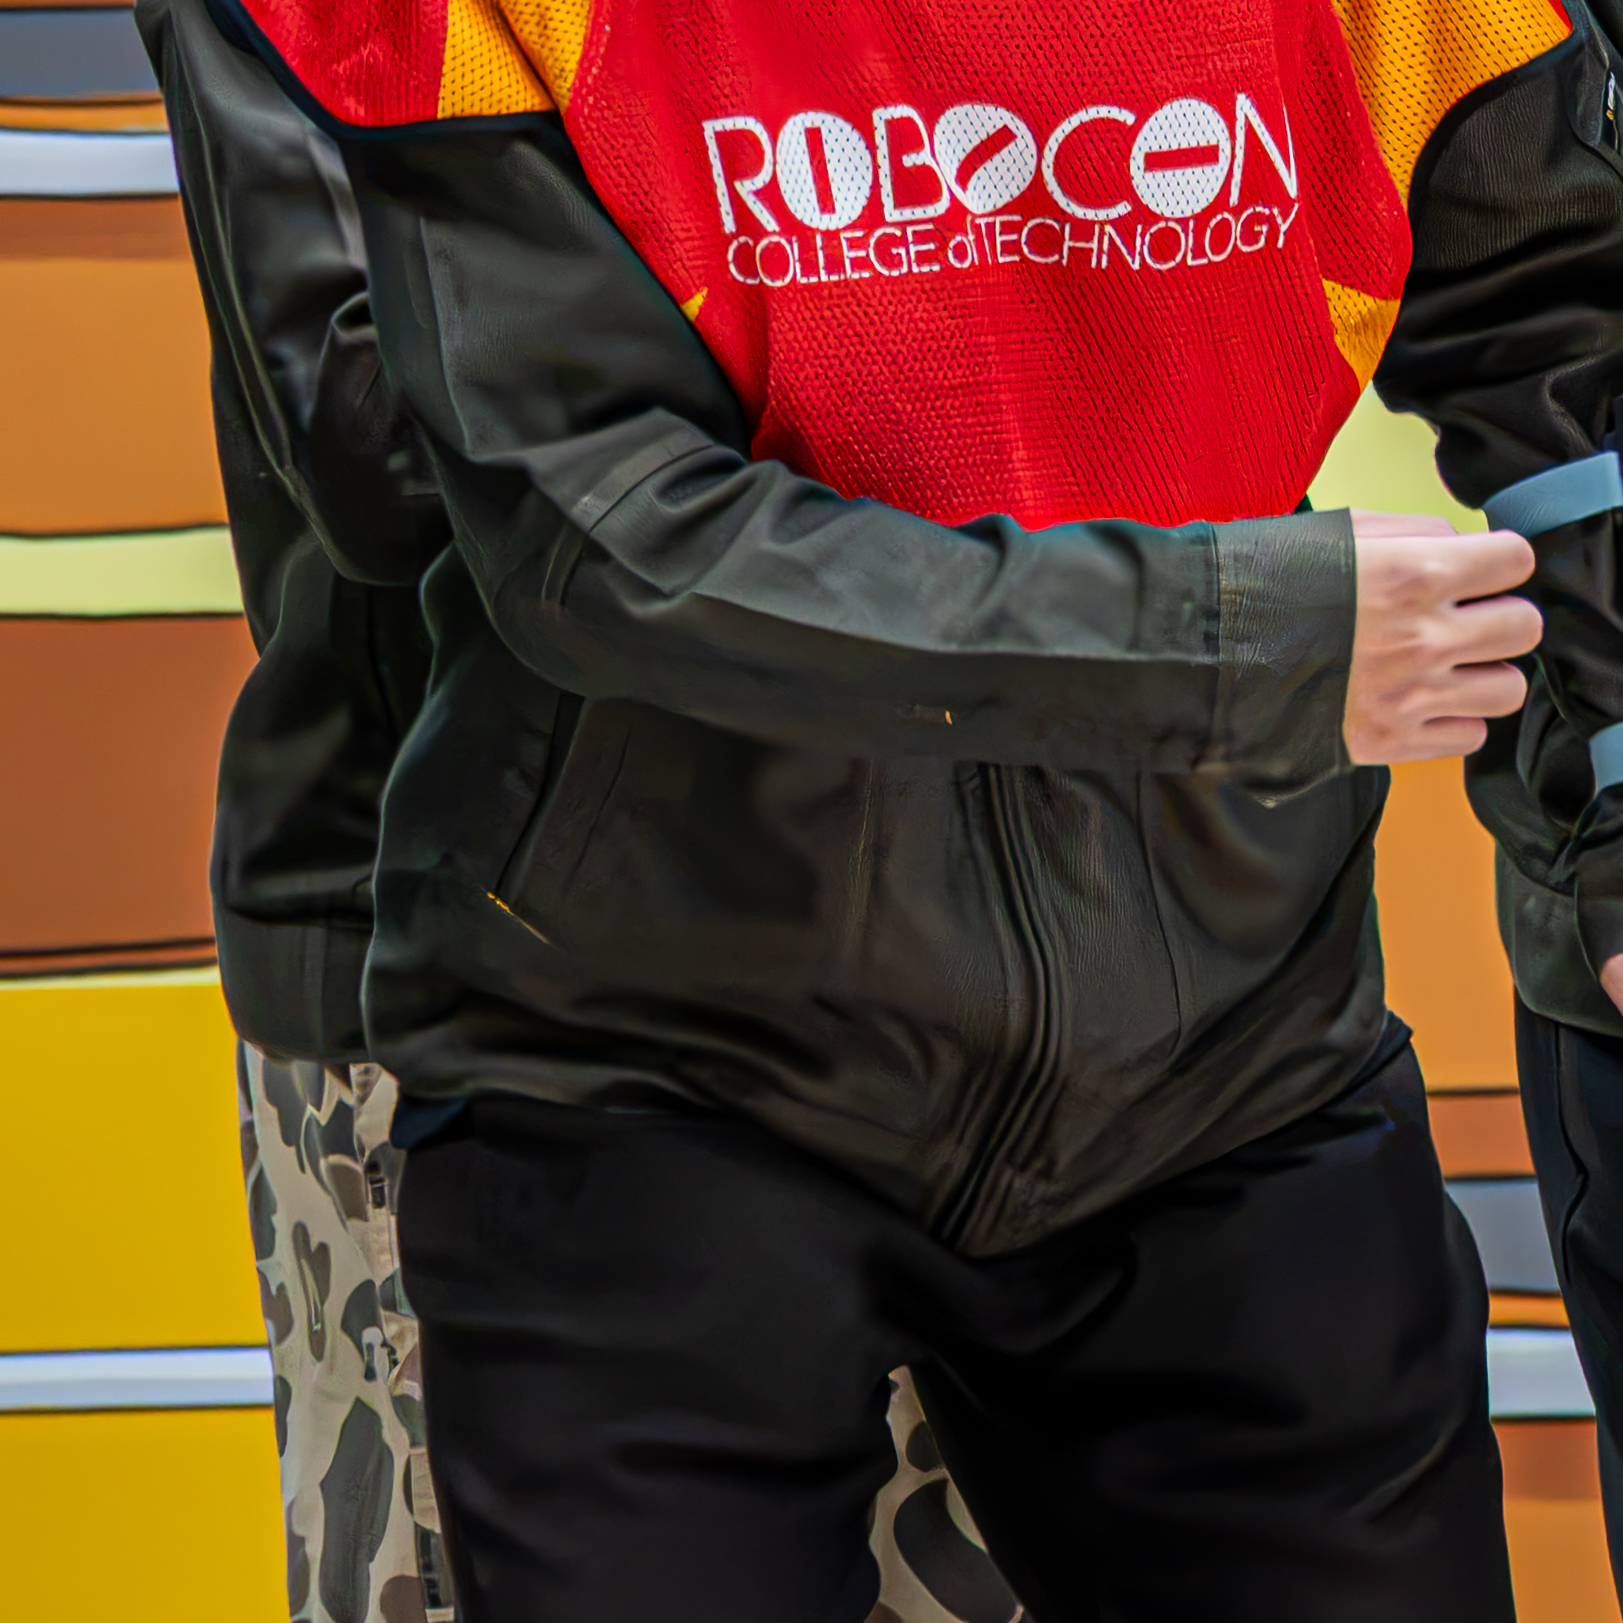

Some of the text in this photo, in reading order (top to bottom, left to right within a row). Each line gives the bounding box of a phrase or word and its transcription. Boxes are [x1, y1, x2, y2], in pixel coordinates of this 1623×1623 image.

[702, 93, 1298, 235] ROBOCON
[726, 222, 942, 288] COLLEGE
[975, 203, 1299, 271] TECHNOLOGY
